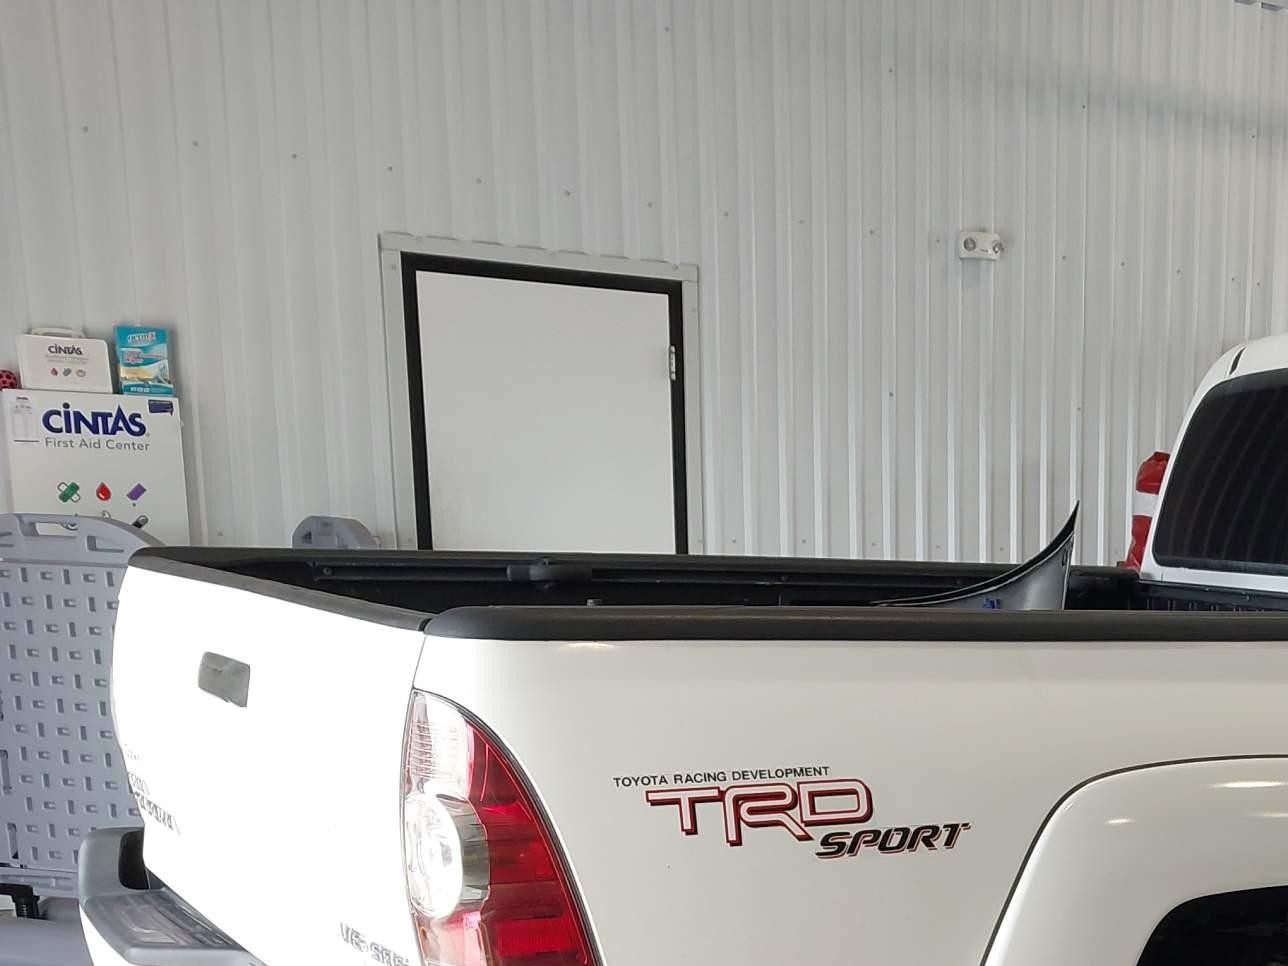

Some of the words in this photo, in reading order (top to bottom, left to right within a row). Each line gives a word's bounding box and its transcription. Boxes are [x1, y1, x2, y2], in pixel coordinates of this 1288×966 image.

[45, 437, 74, 449] First
[79, 437, 101, 450] Aid
[106, 439, 150, 451] Center
[613, 776, 668, 788] TOYOTA
[673, 772, 727, 785] RACING
[732, 766, 830, 782] DEVELOPMENT
[645, 778, 873, 847] TRD
[815, 822, 973, 860] SPORT
